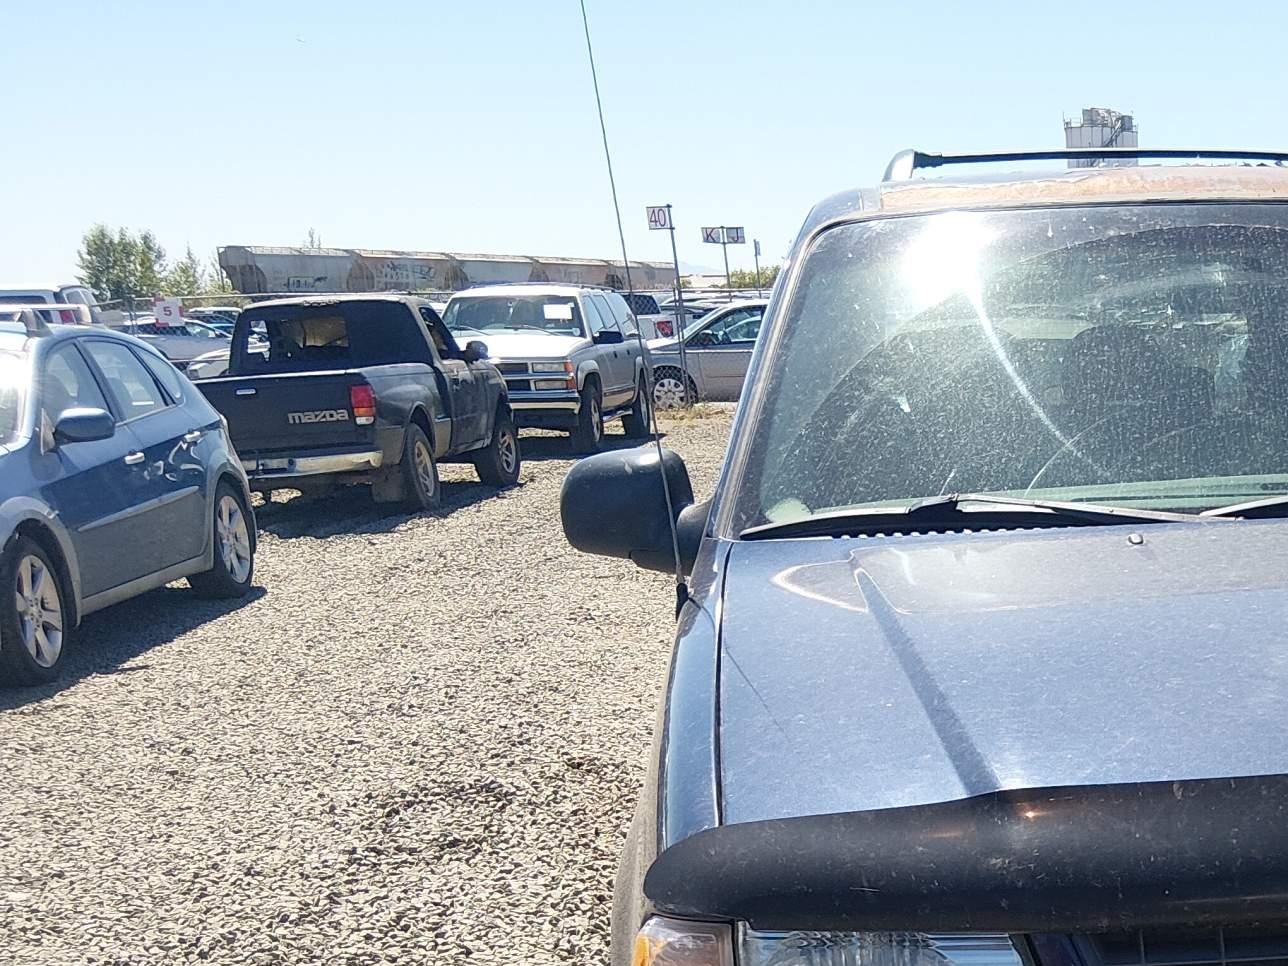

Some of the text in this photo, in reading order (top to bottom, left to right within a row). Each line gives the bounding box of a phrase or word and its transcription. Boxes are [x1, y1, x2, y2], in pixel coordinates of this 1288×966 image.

[649, 208, 667, 227] 40
[705, 227, 717, 242] K
[731, 227, 739, 242] J
[163, 306, 172, 316] 5
